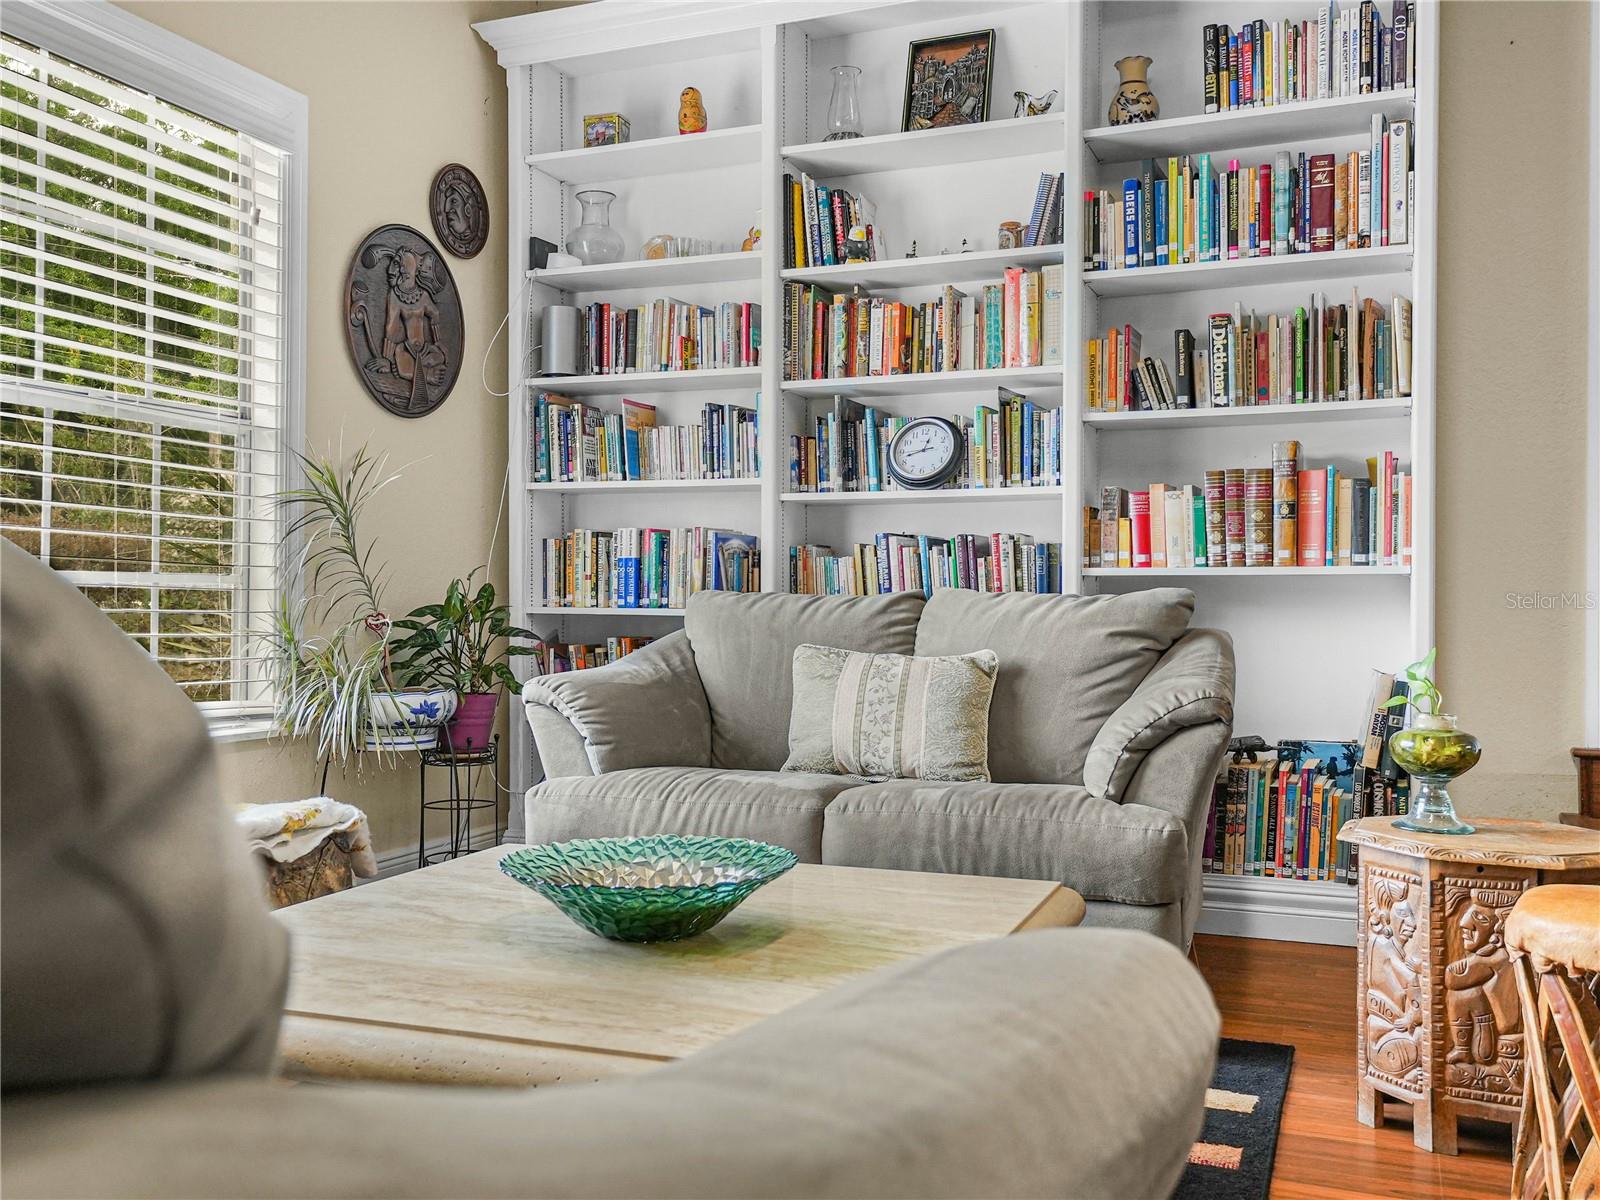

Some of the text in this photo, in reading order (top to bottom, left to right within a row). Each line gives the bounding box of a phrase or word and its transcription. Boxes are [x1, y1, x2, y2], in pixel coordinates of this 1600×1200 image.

[1395, 16, 1406, 40] CEO
[1206, 74, 1216, 97] GETTY
[1392, 143, 1400, 193] MYTHOLOGY
[1126, 190, 1135, 221] IDEAS
[1212, 328, 1228, 405] Dictionary
[1370, 714, 1380, 736] DAYAN
[1373, 783, 1384, 816] COSMOS
[1312, 802, 1320, 828] DESTINOS
